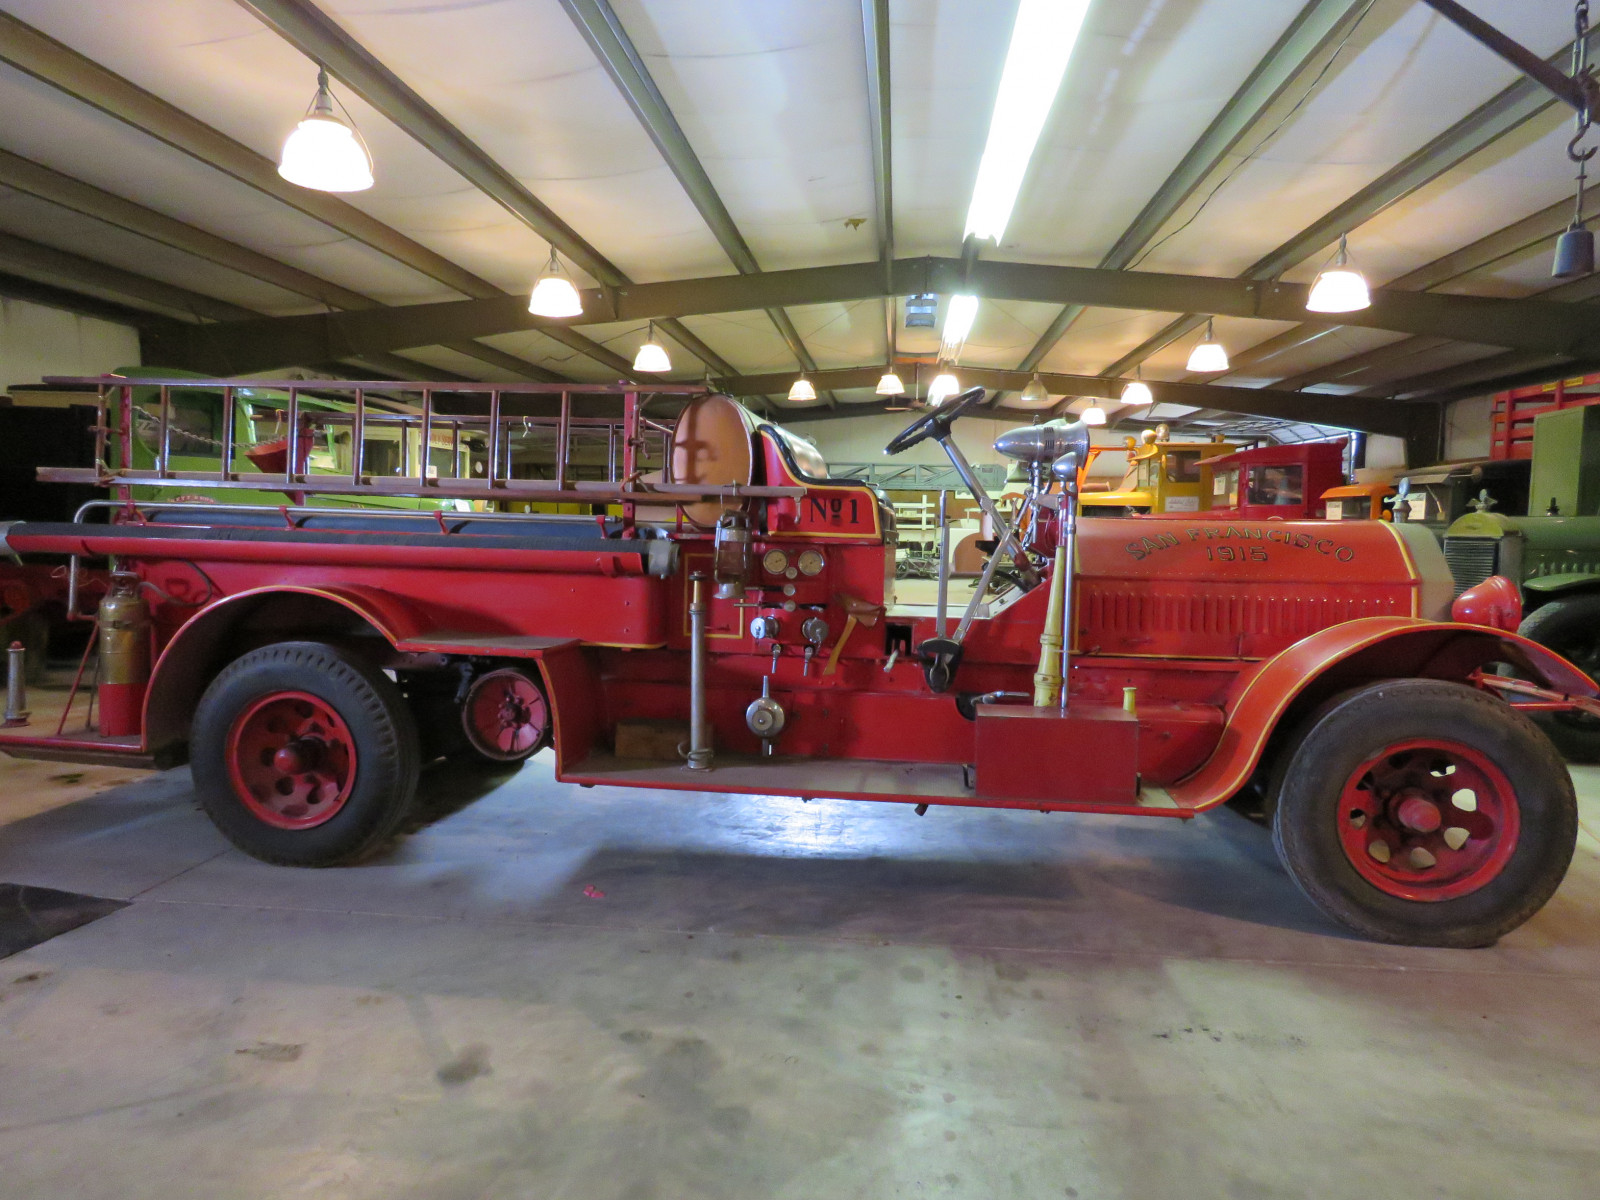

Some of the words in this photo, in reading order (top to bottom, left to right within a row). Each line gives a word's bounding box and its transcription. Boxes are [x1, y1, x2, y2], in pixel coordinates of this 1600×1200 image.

[849, 498, 860, 524] 1
[1125, 531, 1180, 561] SAN
[1185, 526, 1355, 562] FRANCISCO
[1206, 546, 1268, 562] 1915
